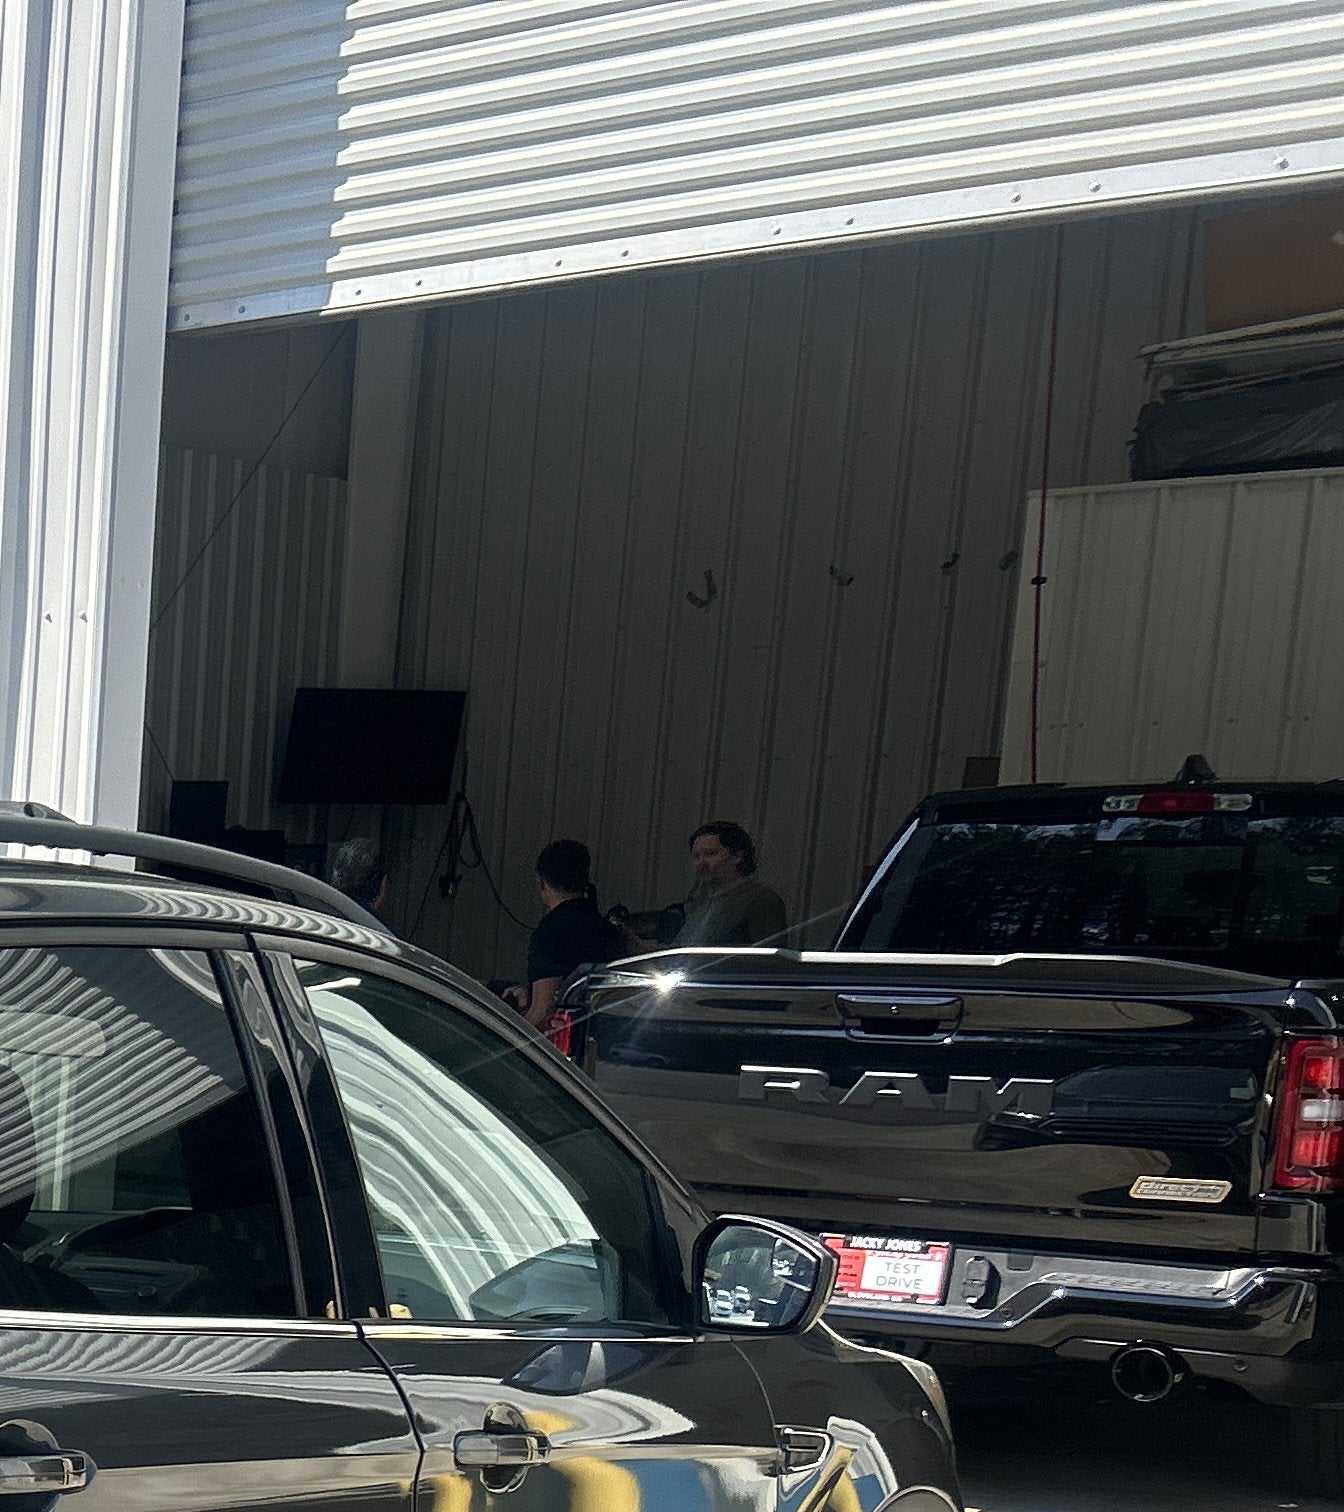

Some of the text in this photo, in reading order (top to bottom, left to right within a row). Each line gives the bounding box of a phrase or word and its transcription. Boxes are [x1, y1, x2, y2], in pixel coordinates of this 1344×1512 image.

[738, 1064, 1055, 1119] RAM
[850, 1236, 921, 1252] JACKY JONES
[885, 1262, 921, 1275] TEST
[876, 1276, 924, 1290] DRIVE
